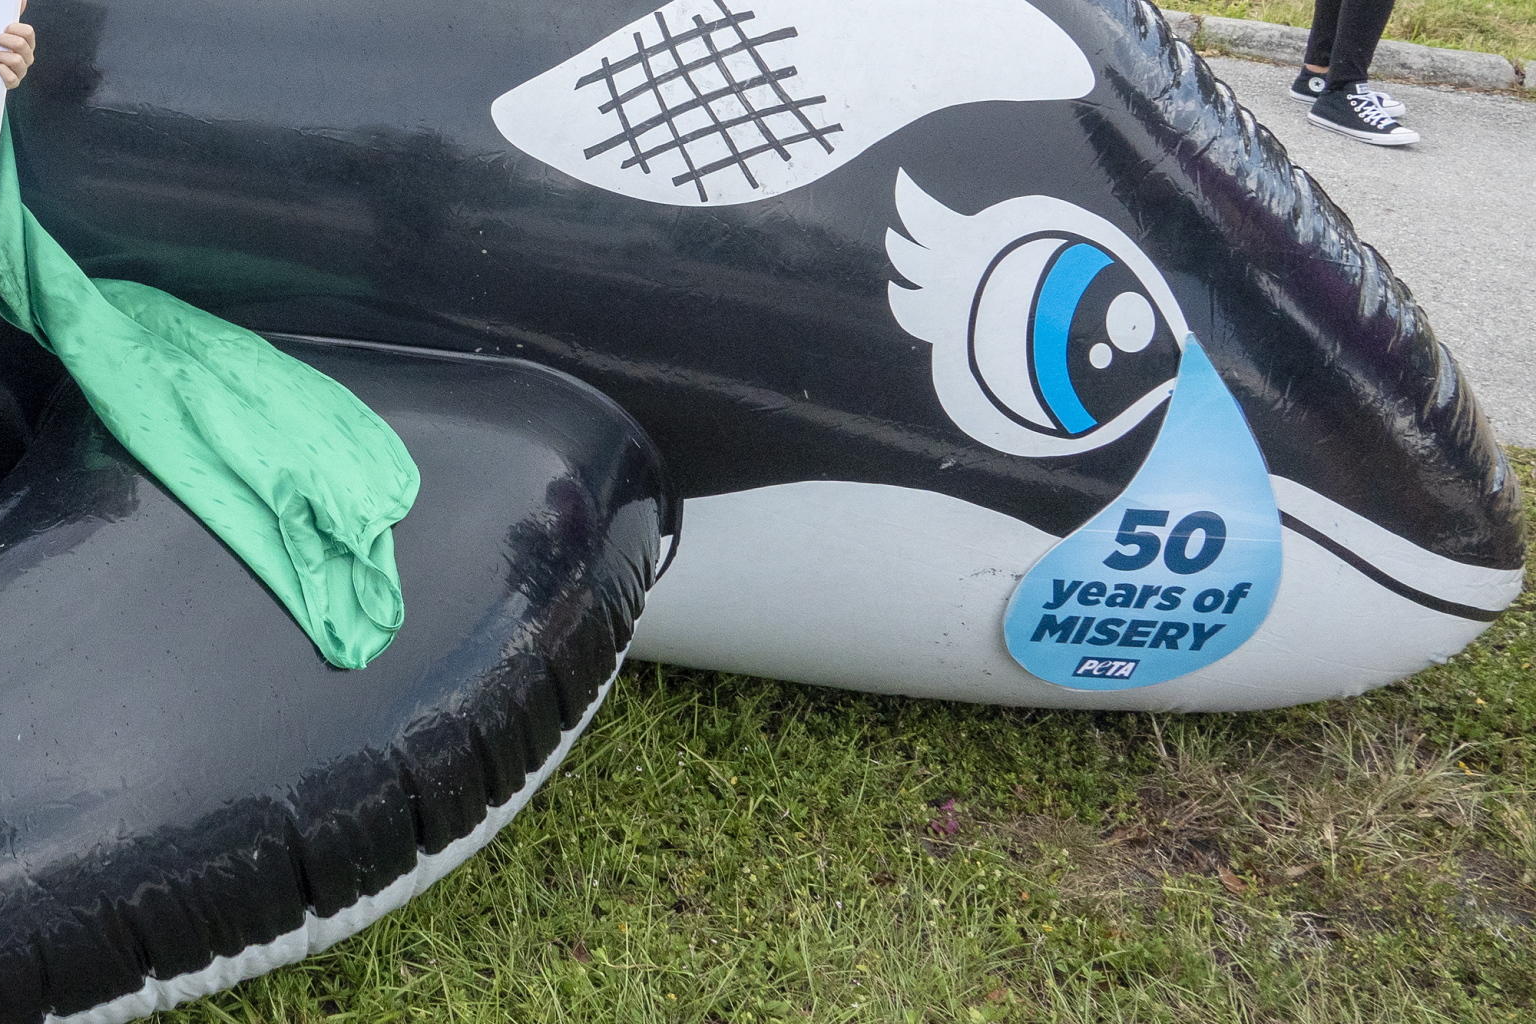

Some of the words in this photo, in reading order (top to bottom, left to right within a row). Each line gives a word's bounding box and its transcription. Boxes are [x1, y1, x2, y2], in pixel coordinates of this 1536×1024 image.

[1102, 508, 1227, 575] 50
[1042, 578, 1186, 611] years
[1192, 582, 1252, 615] of
[1030, 614, 1227, 651] MISERY
